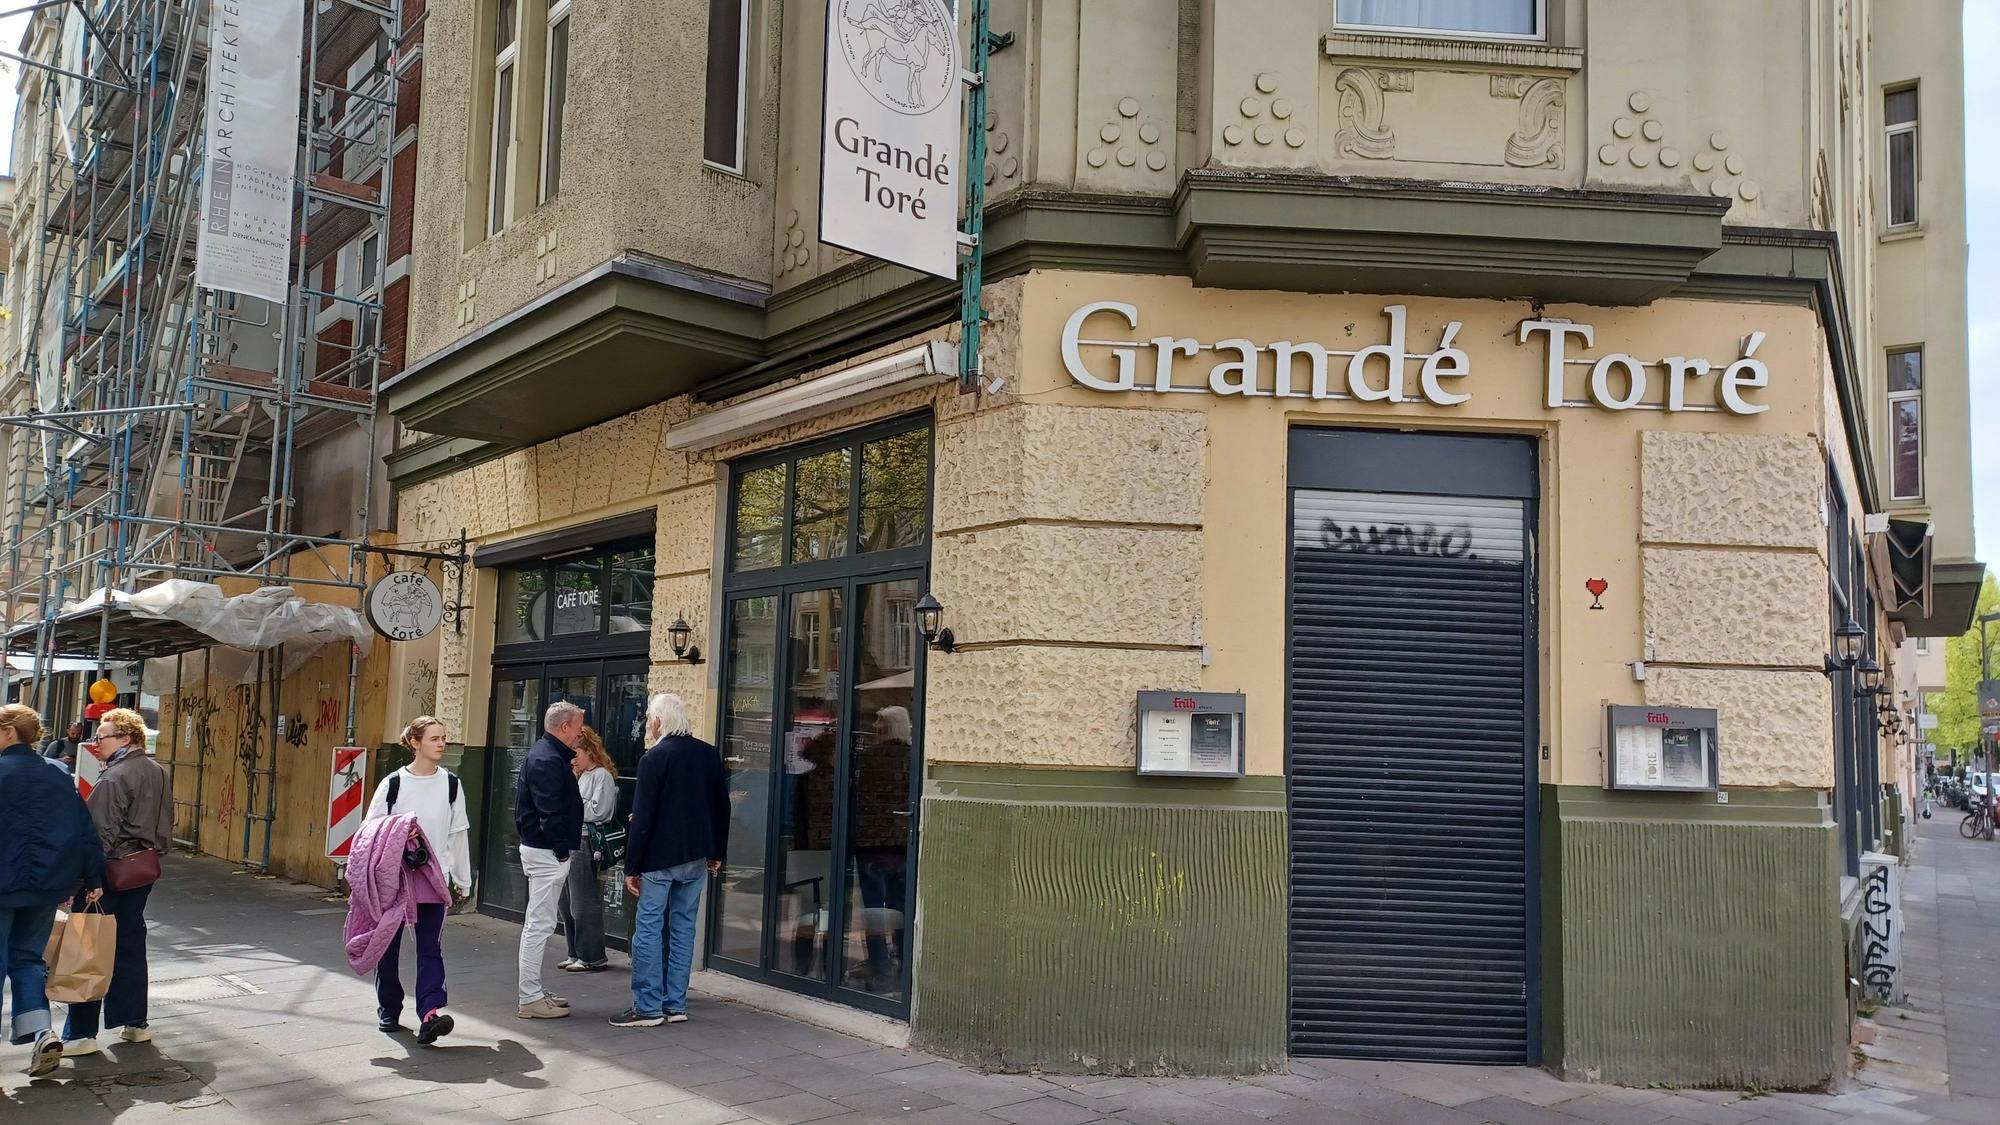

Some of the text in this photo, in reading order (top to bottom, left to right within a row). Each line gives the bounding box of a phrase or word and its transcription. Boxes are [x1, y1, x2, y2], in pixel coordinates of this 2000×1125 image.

[834, 116, 950, 186] Grandé
[236, 163, 288, 183] HOCHBAU
[855, 166, 927, 220] Toré
[233, 211, 287, 229] NEUBAU
[232, 221, 286, 239] UMBAU
[232, 231, 285, 250] DENKMALSCHUTZ
[1060, 301, 1771, 417] Grandé Toré
[393, 572, 424, 586] café
[557, 586, 599, 609] CAFÉ TORÉ
[391, 626, 424, 640] toré
